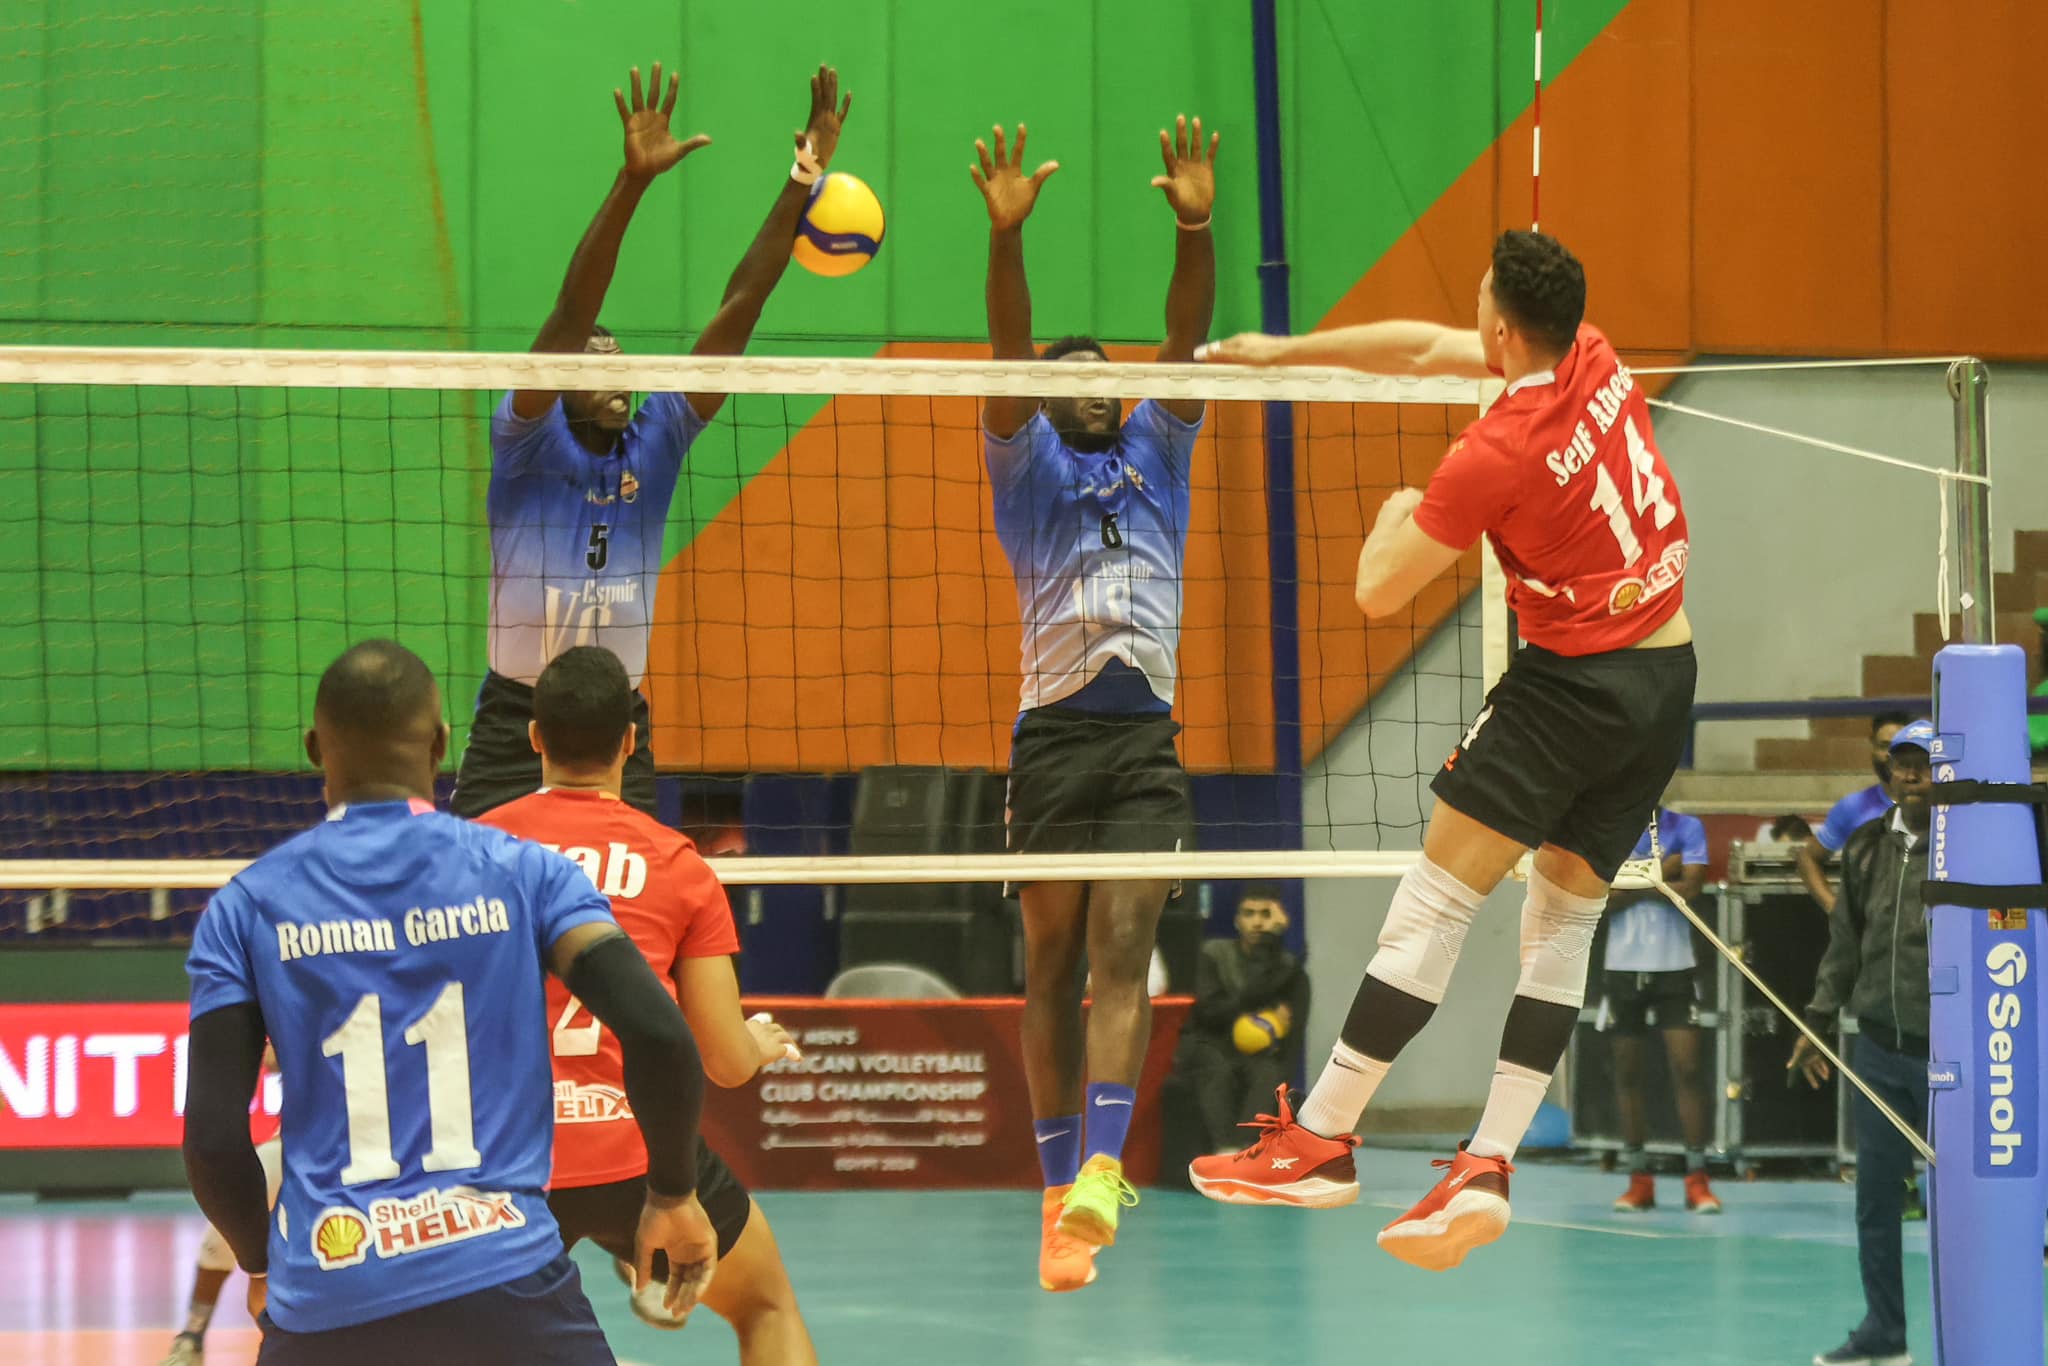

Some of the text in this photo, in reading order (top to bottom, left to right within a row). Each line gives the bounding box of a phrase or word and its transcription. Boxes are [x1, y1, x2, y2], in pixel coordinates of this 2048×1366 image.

[1590, 415, 1677, 570] 14
[585, 523, 609, 572] 5
[1101, 512, 1123, 549] 6
[541, 842, 647, 898] ab
[276, 921, 396, 961] Roman
[321, 981, 481, 1185] 11
[859, 1056, 984, 1072] VOLLEYBALL
[1988, 993, 2021, 1166] Senoh
[557, 1097, 633, 1118] ELIX
[761, 1083, 986, 1101] CLUB CHAMPIONSHIP
[375, 1194, 436, 1224] Shell
[377, 1198, 515, 1251] HELIX
